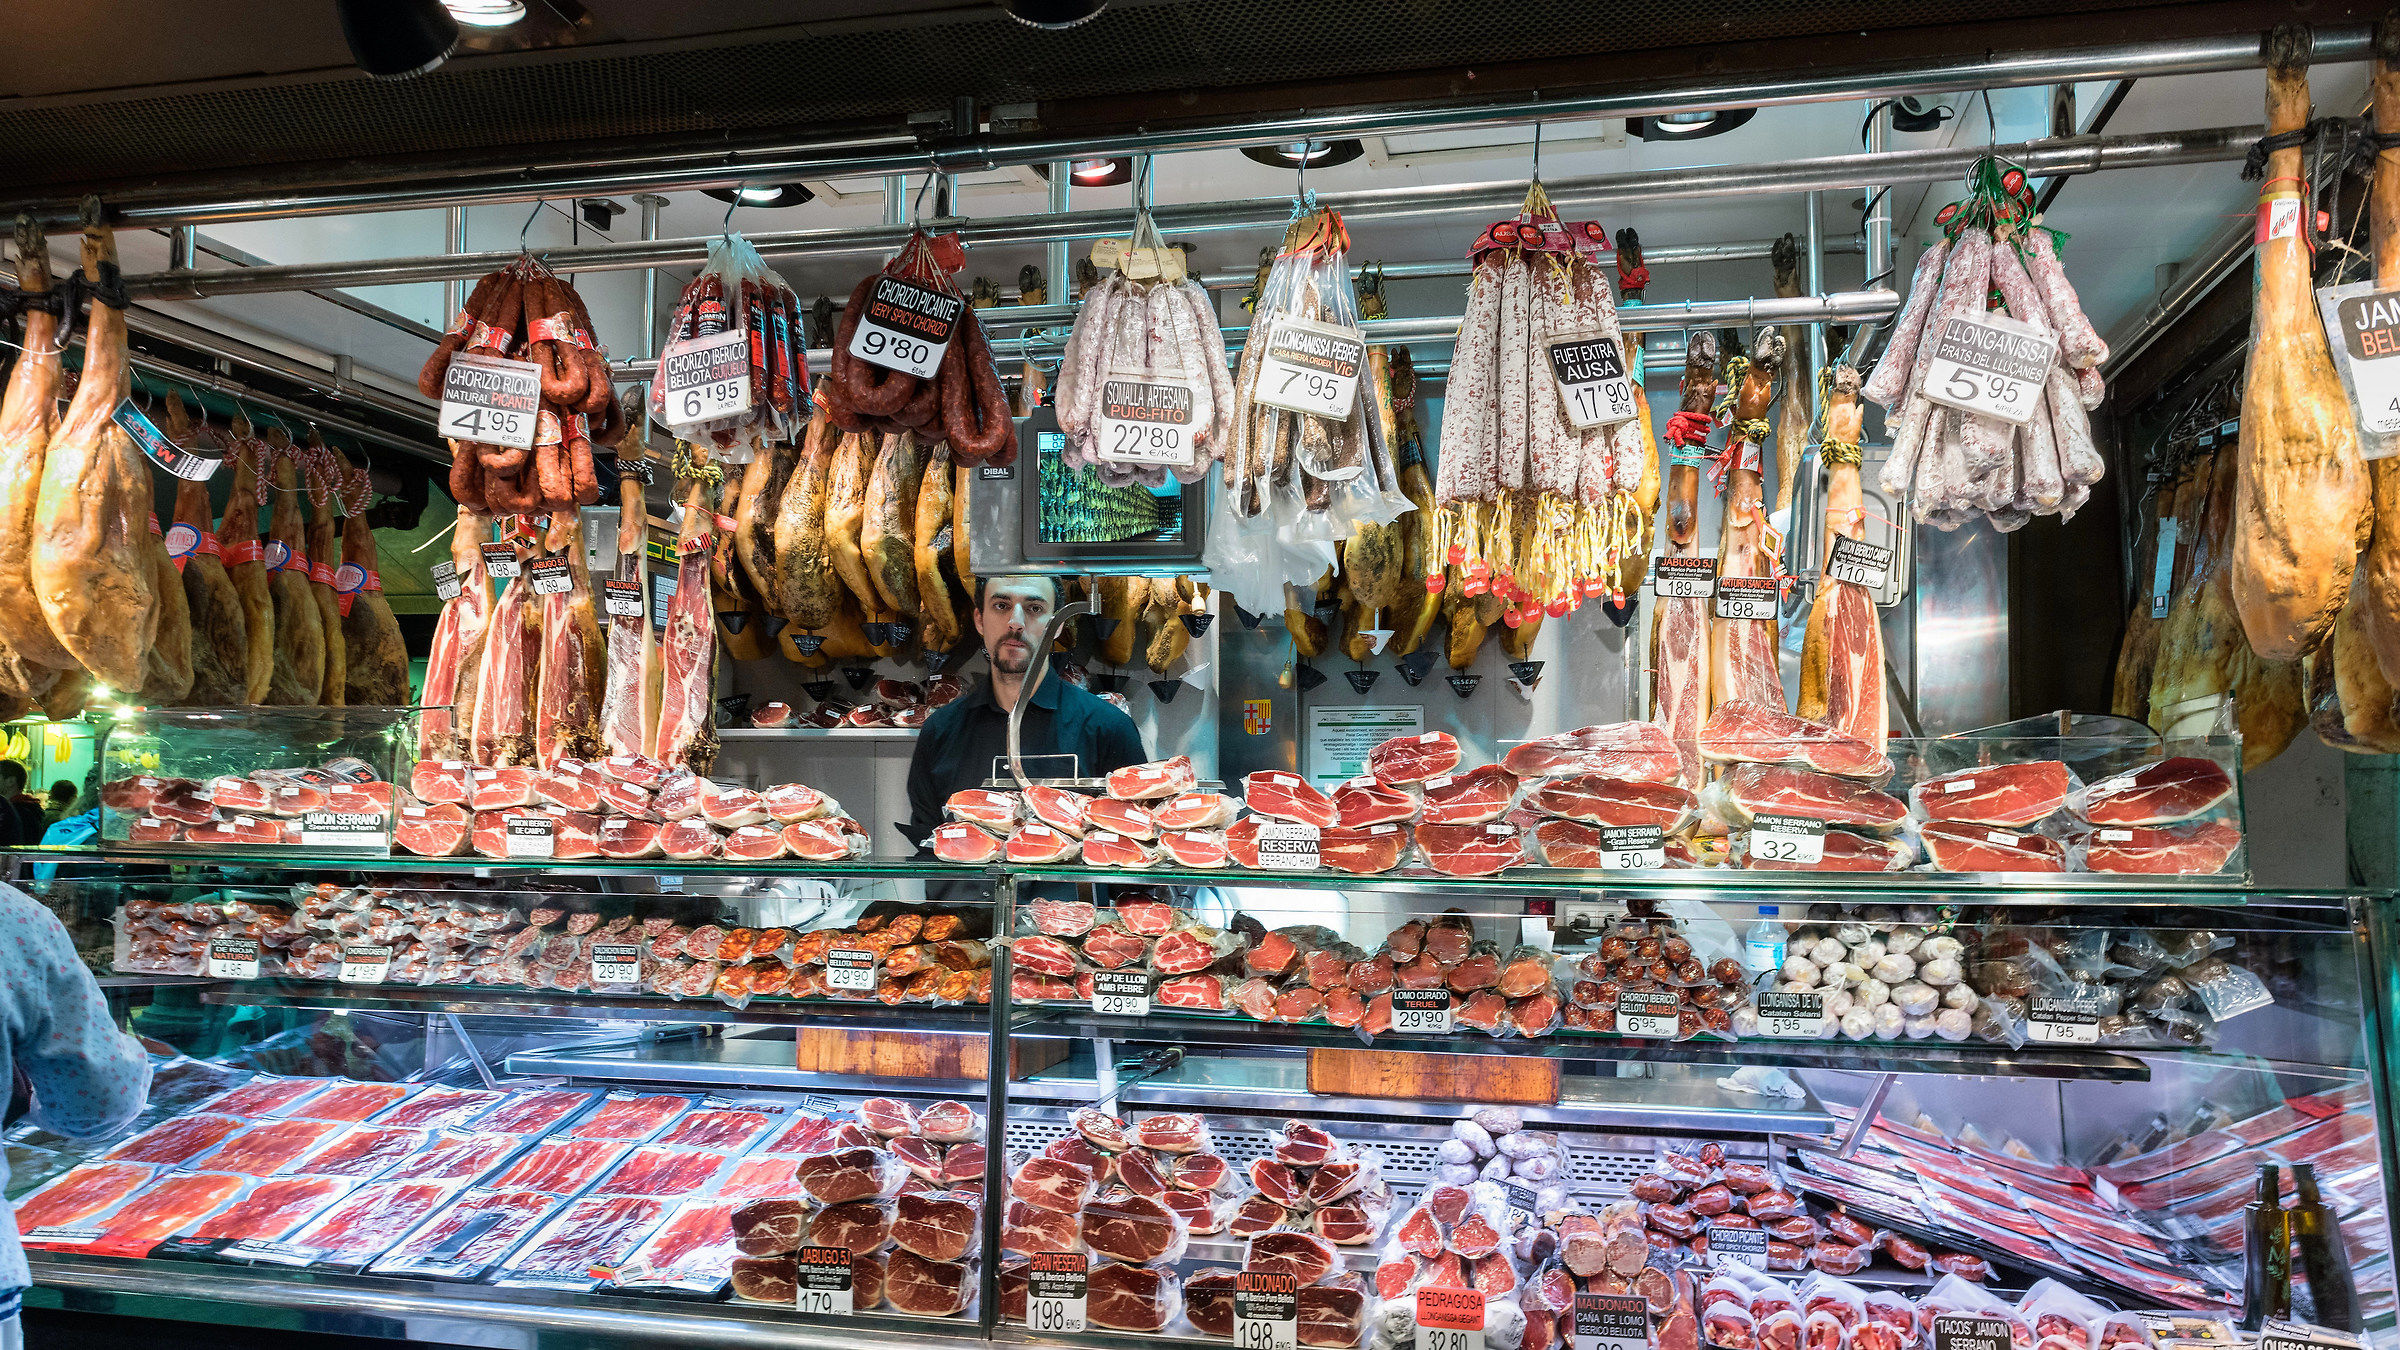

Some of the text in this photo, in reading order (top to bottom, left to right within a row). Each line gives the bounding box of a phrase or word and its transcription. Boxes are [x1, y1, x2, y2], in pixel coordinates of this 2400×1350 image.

[877, 279, 958, 322] CHORIZO PICANTE
[870, 301, 948, 337] VERY SPICY CHORIZO
[862, 331, 929, 364] 9'80
[1274, 328, 1360, 365] LLONGANISSA PEBRE
[1944, 318, 2049, 365] LLONGANISSA
[668, 343, 746, 375] CHORIZO IBERICO
[1553, 342, 1615, 365] FUET EXTRA
[1273, 348, 1353, 377] CASA RIERA ORDEIX Vic
[1940, 343, 2044, 382] PRATS DEL LLUÇANES
[670, 361, 747, 388] BELLOTA GUIJUELO
[1566, 360, 1618, 381] AUSA
[448, 368, 535, 396] CHORIZO RIOJA
[1278, 367, 1339, 400] 7'95
[1945, 367, 2022, 403] 5'95
[446, 388, 535, 411] NATURAL PICANTE
[683, 381, 739, 417] 6'95
[1107, 381, 1189, 410] SOMALLA ARTESANA
[1574, 381, 1630, 420] 17'90
[451, 408, 518, 436] 4'95
[124, 412, 176, 464] Marcos
[1112, 423, 1179, 456] 22'80
[490, 563, 510, 576] 198
[532, 559, 557, 570] JABUGO
[1661, 558, 1714, 568] JABUGO 5J
[1837, 563, 1865, 583] 110
[541, 580, 559, 593] 189
[606, 580, 640, 590] MALDONADO
[1586, 583, 1603, 591] AUSA
[1668, 581, 1692, 596] 189
[1721, 579, 1776, 589] ARTURO SANCHEZ
[613, 601, 630, 614] 198
[1723, 601, 1754, 617] 198
[304, 813, 381, 826] JAMON SERRANO
[1754, 816, 1822, 829] JAMON SERRANO
[524, 827, 546, 835] CAMPO
[1262, 828, 1318, 839] JAMON SERRANO
[1603, 827, 1661, 838] JAMON SERRANO
[1770, 825, 1809, 835] RESERVA
[1261, 840, 1319, 853] RESERVA
[1763, 840, 1797, 860] 32
[1261, 854, 1316, 866] SERRANO HAM
[1620, 852, 1643, 868] 50
[213, 952, 255, 961] NATURAL
[829, 959, 852, 967] BELLOTA
[830, 951, 873, 960] CHORIZO IBERICO
[599, 964, 633, 979] 29'90
[833, 969, 869, 984] 29'90
[1095, 973, 1148, 984] CAP DE LLOM
[1098, 983, 1144, 994] AMB PEBRE
[1394, 991, 1447, 1000] LOMO CURADO
[1102, 996, 1138, 1013] 29'90
[1405, 1000, 1439, 1008] TERUEL
[1620, 992, 1676, 1005] CHORIZO IBERICO
[1760, 992, 1822, 1009] LLONGANISSA DE VIC
[2032, 997, 2098, 1014] LLONGANISSA PEBRE
[1620, 1002, 1677, 1015] BELLOTA GUIJUELO
[1761, 1009, 1821, 1018] Catalan Salami
[1399, 1011, 1444, 1028] 29'90
[1628, 1017, 1656, 1032] 6'95
[2031, 1012, 2097, 1022] Catalan Pepper Salami
[1772, 1019, 1801, 1035] 5'95
[2044, 1024, 2074, 1040] 7'95
[1711, 1229, 1765, 1244] CHORIZO PICANTE
[1711, 1242, 1726, 1250] VERY
[801, 1248, 851, 1265] JABUGO 5J
[1031, 1254, 1086, 1272] GRAN RESERVA
[1030, 1271, 1086, 1282] 100% Iberico Bellota
[1236, 1274, 1295, 1293] MALDONADO
[801, 1292, 832, 1314] 179
[1419, 1291, 1484, 1310] PEDRAGOSA
[1577, 1298, 1645, 1313] MALDONADO
[1032, 1300, 1064, 1330] 198
[1421, 1312, 1481, 1323] LLONGANISSA GEGANT
[1576, 1312, 1645, 1326] CAÑA DE LOMO
[1239, 1321, 1273, 1350] 198
[1578, 1325, 1644, 1338] IBERICO BELLOTA
[1975, 1322, 2009, 1338] JAMON
[1950, 1337, 1997, 1350] SERRANO
